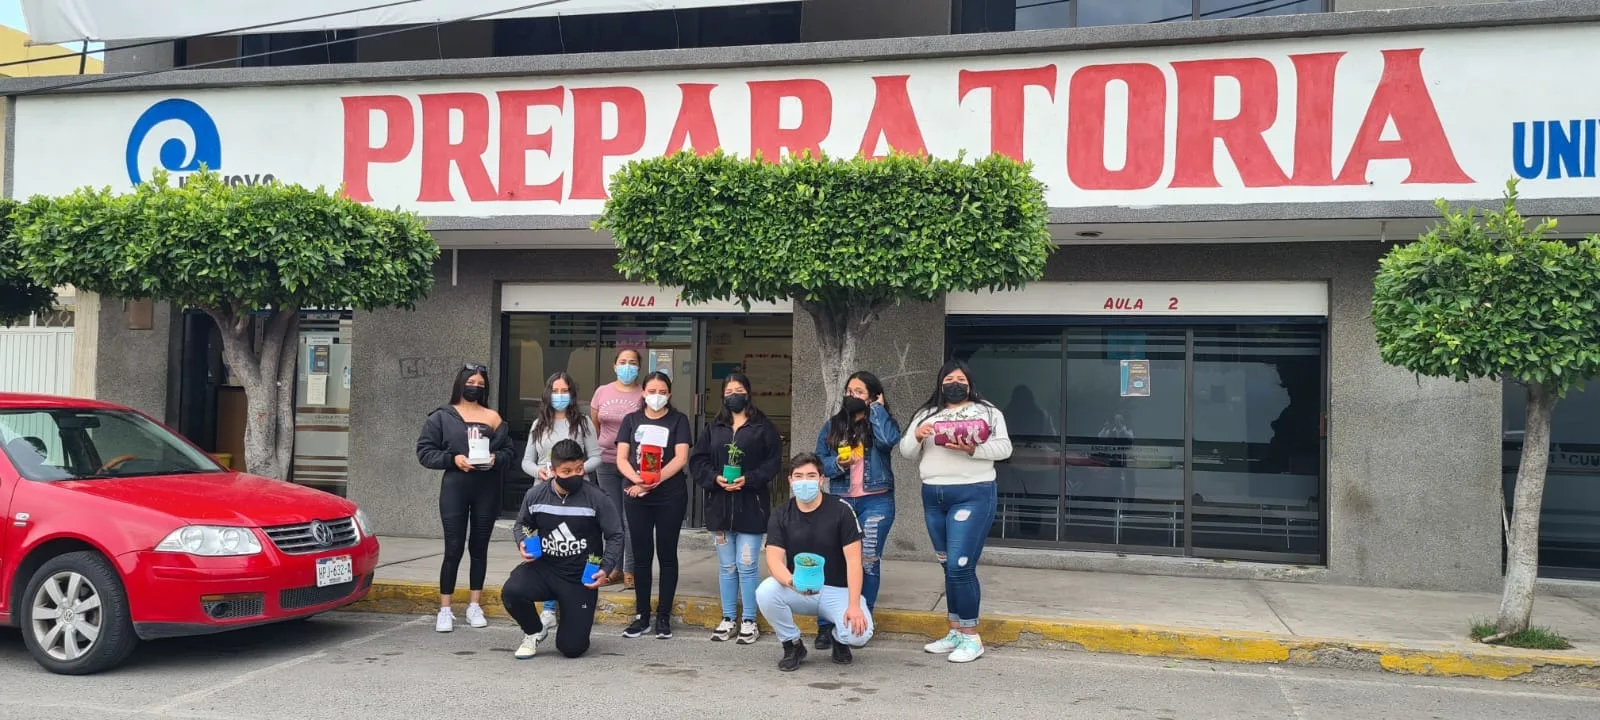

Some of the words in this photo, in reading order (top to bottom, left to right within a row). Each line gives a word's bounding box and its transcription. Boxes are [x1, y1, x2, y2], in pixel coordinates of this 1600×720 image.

[340, 48, 1476, 204] PREPARATORIA
[1512, 119, 1600, 180] UNI
[621, 295, 655, 307] AULA
[1103, 297, 1144, 310] AULA
[1168, 296, 1178, 310] 2
[541, 537, 588, 553] adidas
